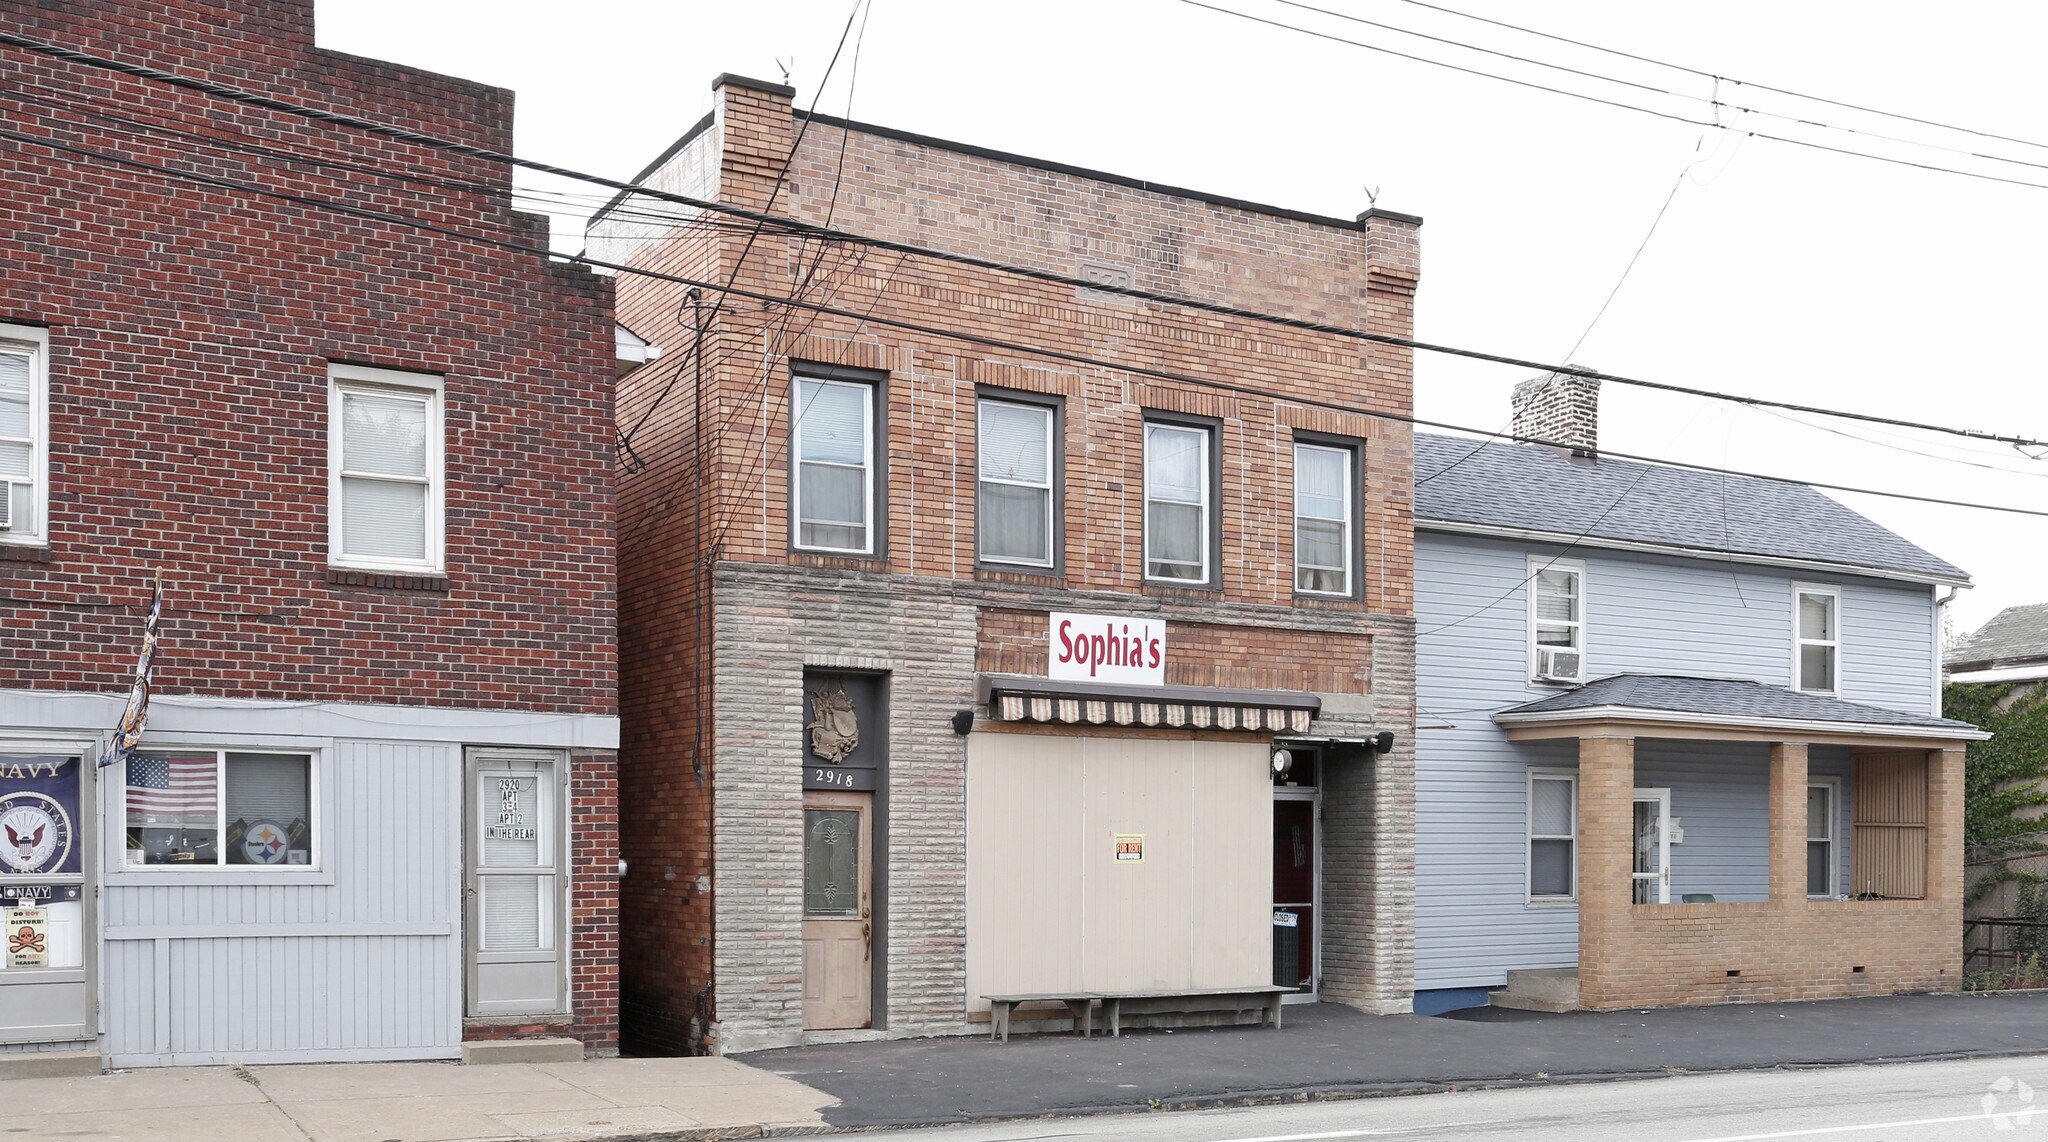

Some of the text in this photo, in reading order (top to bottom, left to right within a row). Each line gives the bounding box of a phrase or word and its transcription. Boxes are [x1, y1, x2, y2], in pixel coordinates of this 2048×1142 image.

[1058, 619, 1160, 677] Sophia's
[815, 769, 853, 787] 2918
[499, 779, 520, 790] 2920
[502, 791, 517, 801] APT
[39, 800, 67, 847] STATES
[499, 813, 523, 825] APT 2
[486, 825, 535, 839] IN THE REAR
[1117, 843, 1140, 853] FOR RENT
[17, 886, 50, 898] NAVY
